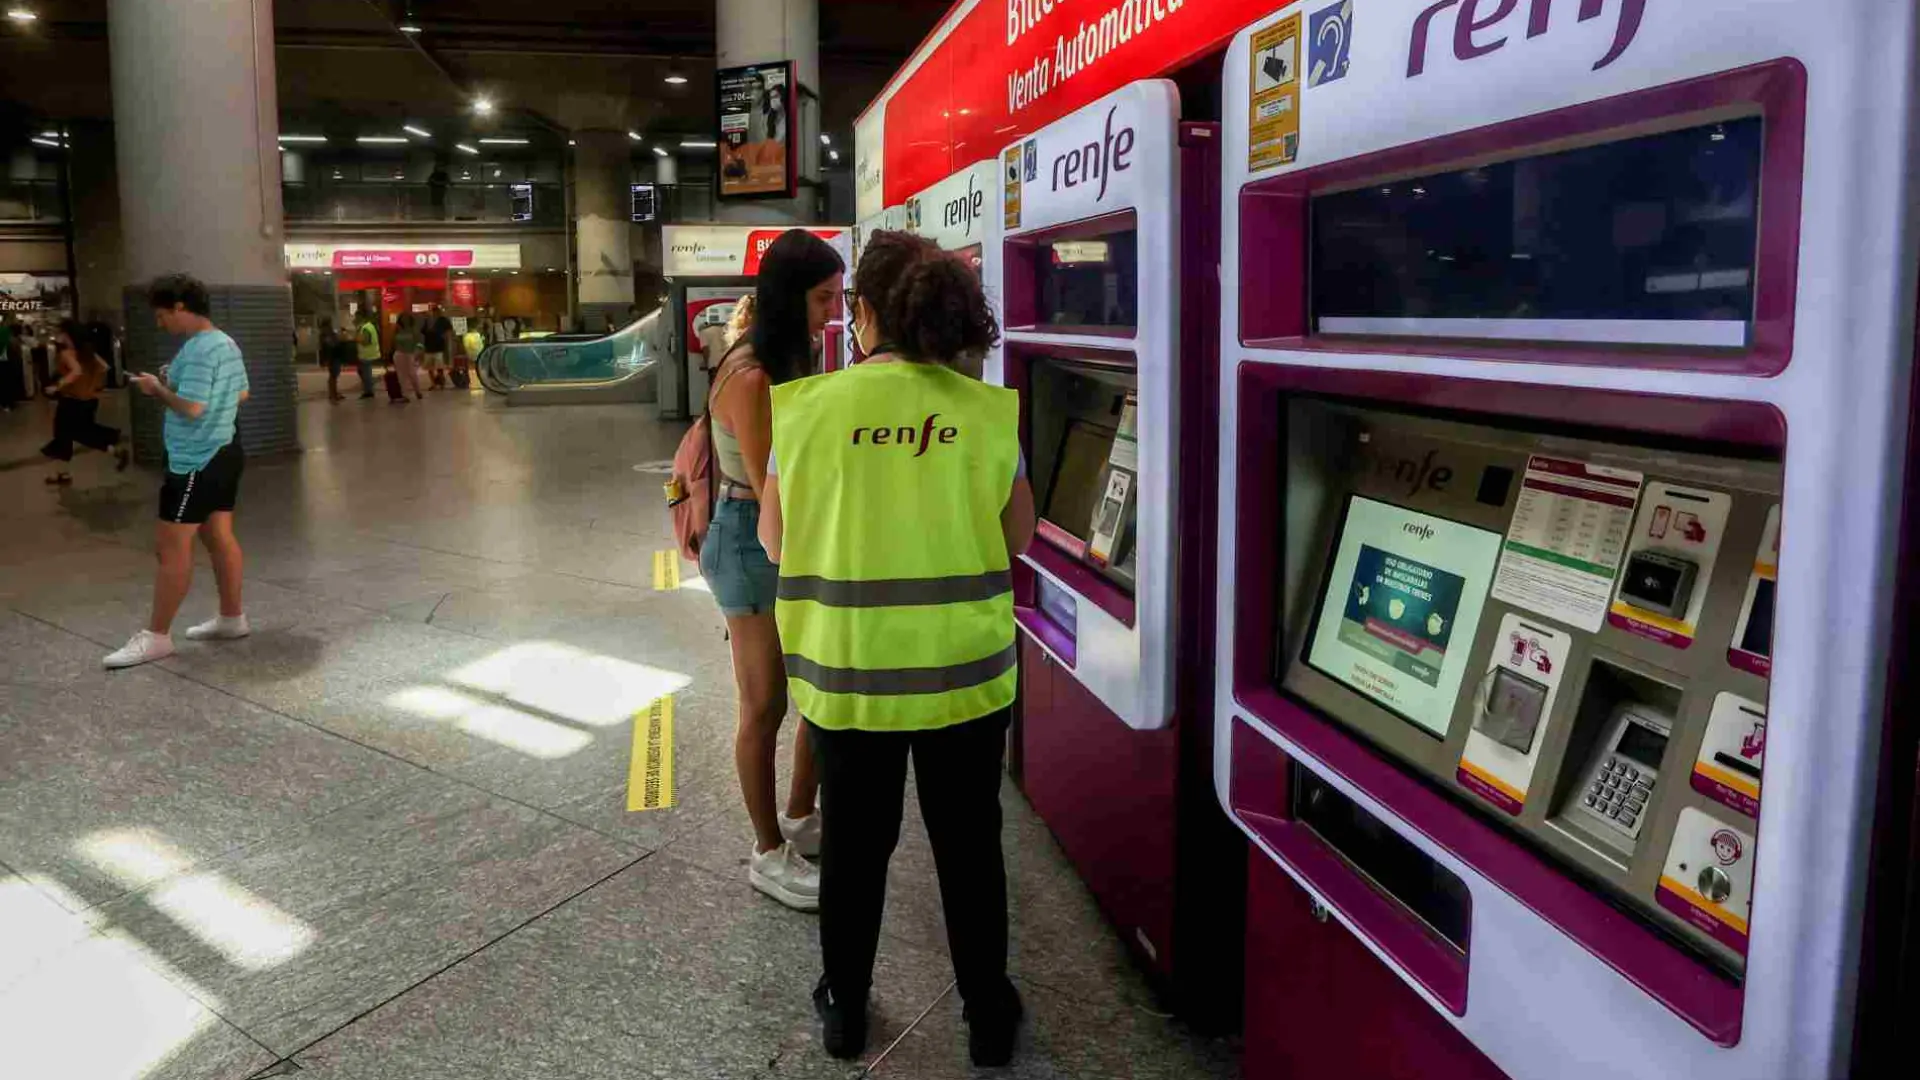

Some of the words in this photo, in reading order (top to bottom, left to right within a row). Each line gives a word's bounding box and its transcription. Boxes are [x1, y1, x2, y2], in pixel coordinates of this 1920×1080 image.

[1007, 57, 1050, 115] Venta
[1051, 104, 1135, 203] renfe
[943, 172, 983, 238] renfe
[670, 242, 707, 255] renfe
[852, 413, 958, 458] renfe
[1402, 521, 1435, 542] renfe
